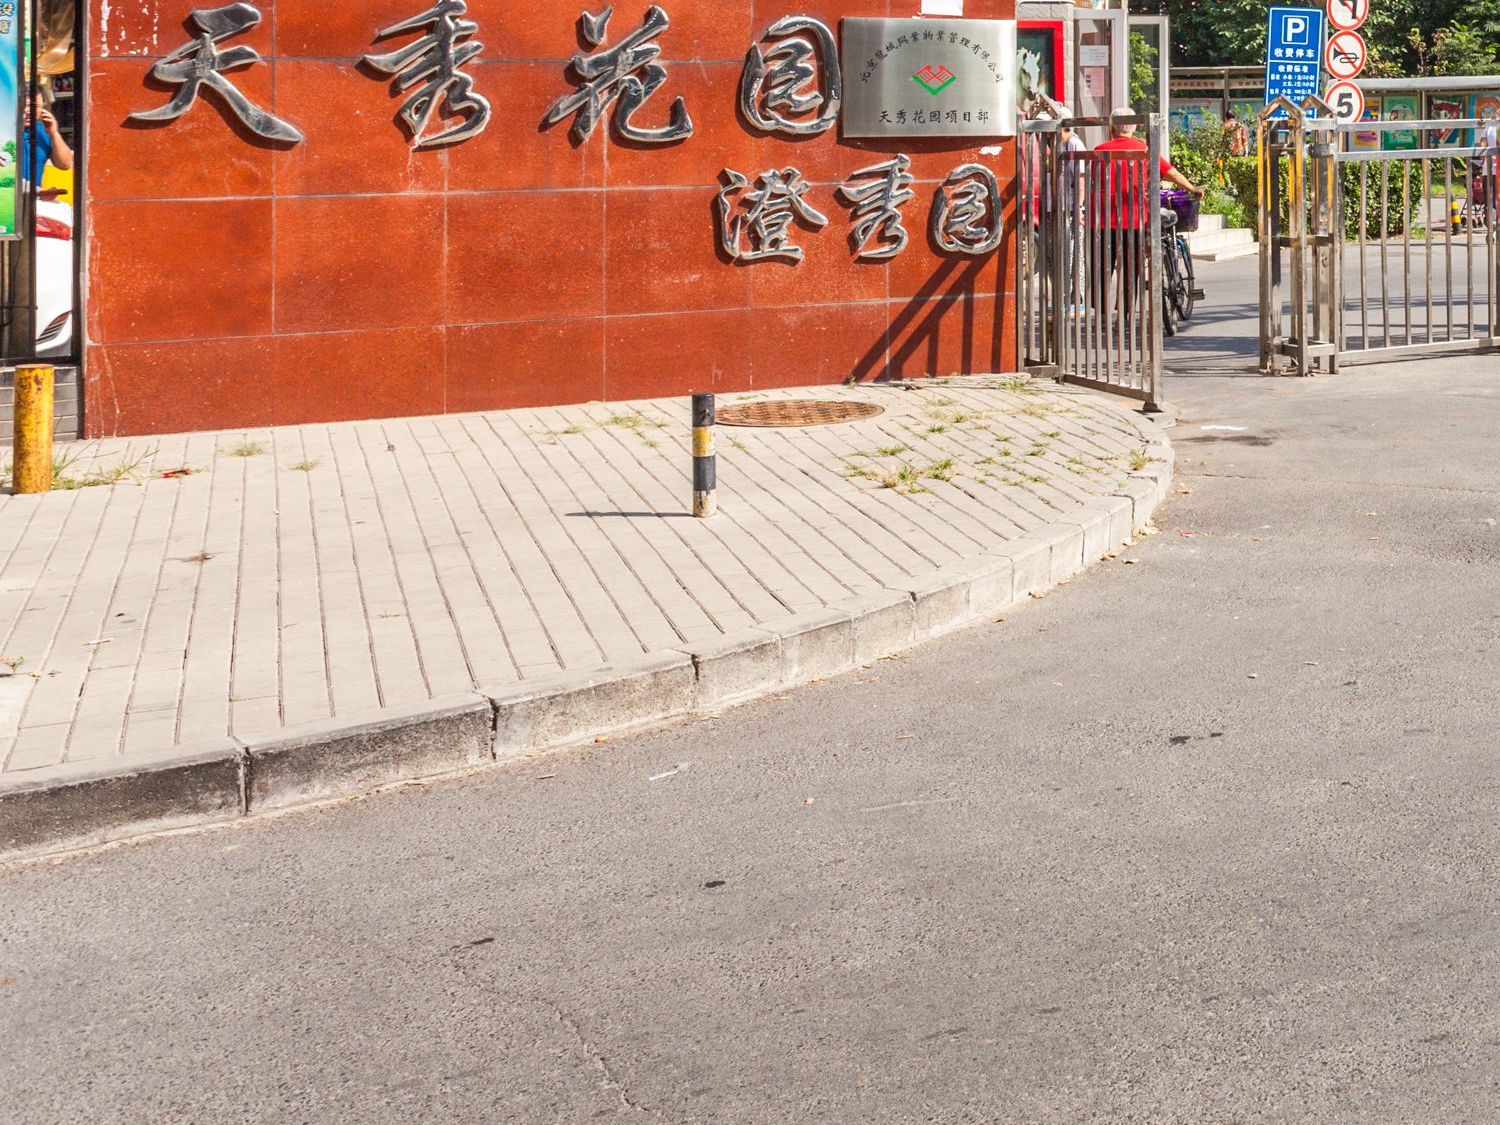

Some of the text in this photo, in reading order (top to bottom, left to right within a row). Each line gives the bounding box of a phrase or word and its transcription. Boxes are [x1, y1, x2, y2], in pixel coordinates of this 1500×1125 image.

[1286, 18, 1305, 42] P
[1274, 48, 1315, 59] 收费停车
[878, 108, 989, 124] 天秀花园项目部
[1337, 93, 1353, 118] 5
[718, 153, 1003, 260] 澄秀园
